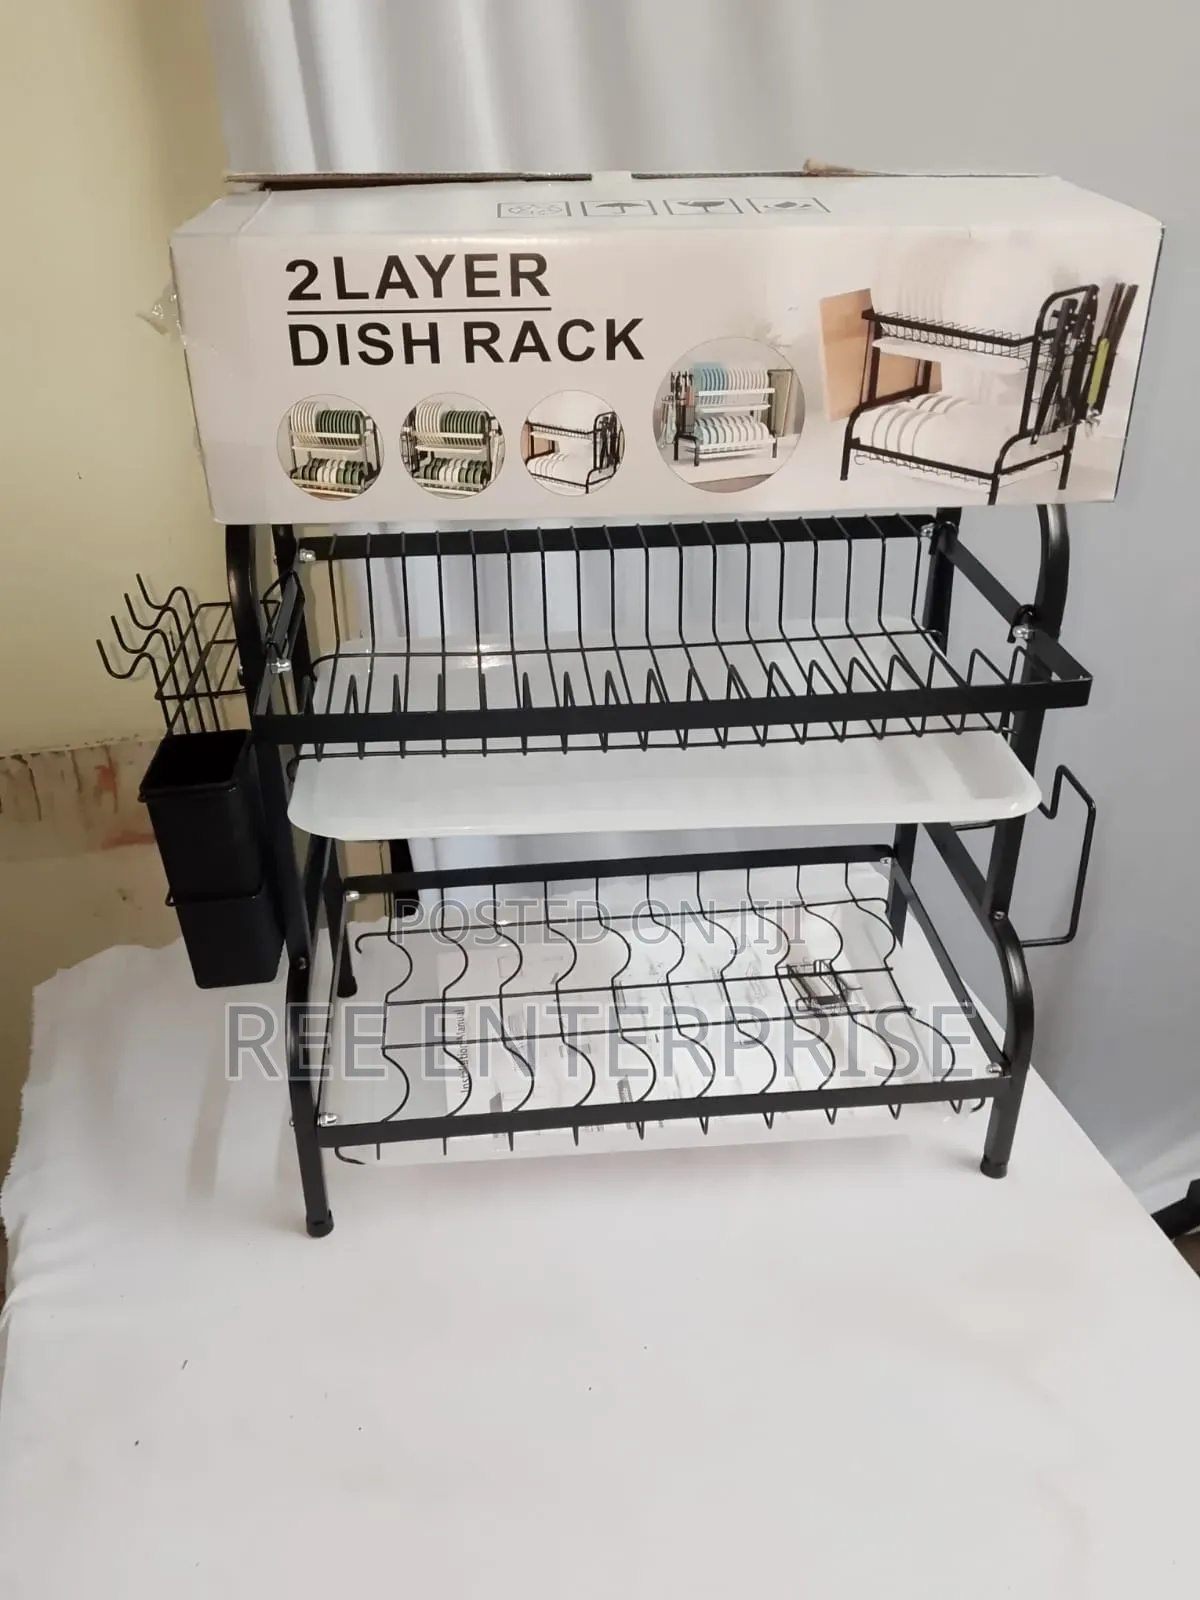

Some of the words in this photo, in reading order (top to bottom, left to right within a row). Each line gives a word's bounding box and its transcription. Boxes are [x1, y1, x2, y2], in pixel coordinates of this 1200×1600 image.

[285, 258, 321, 301] 2
[333, 252, 551, 301] LAYER
[288, 321, 439, 367] DISH
[463, 317, 645, 364] RACK
